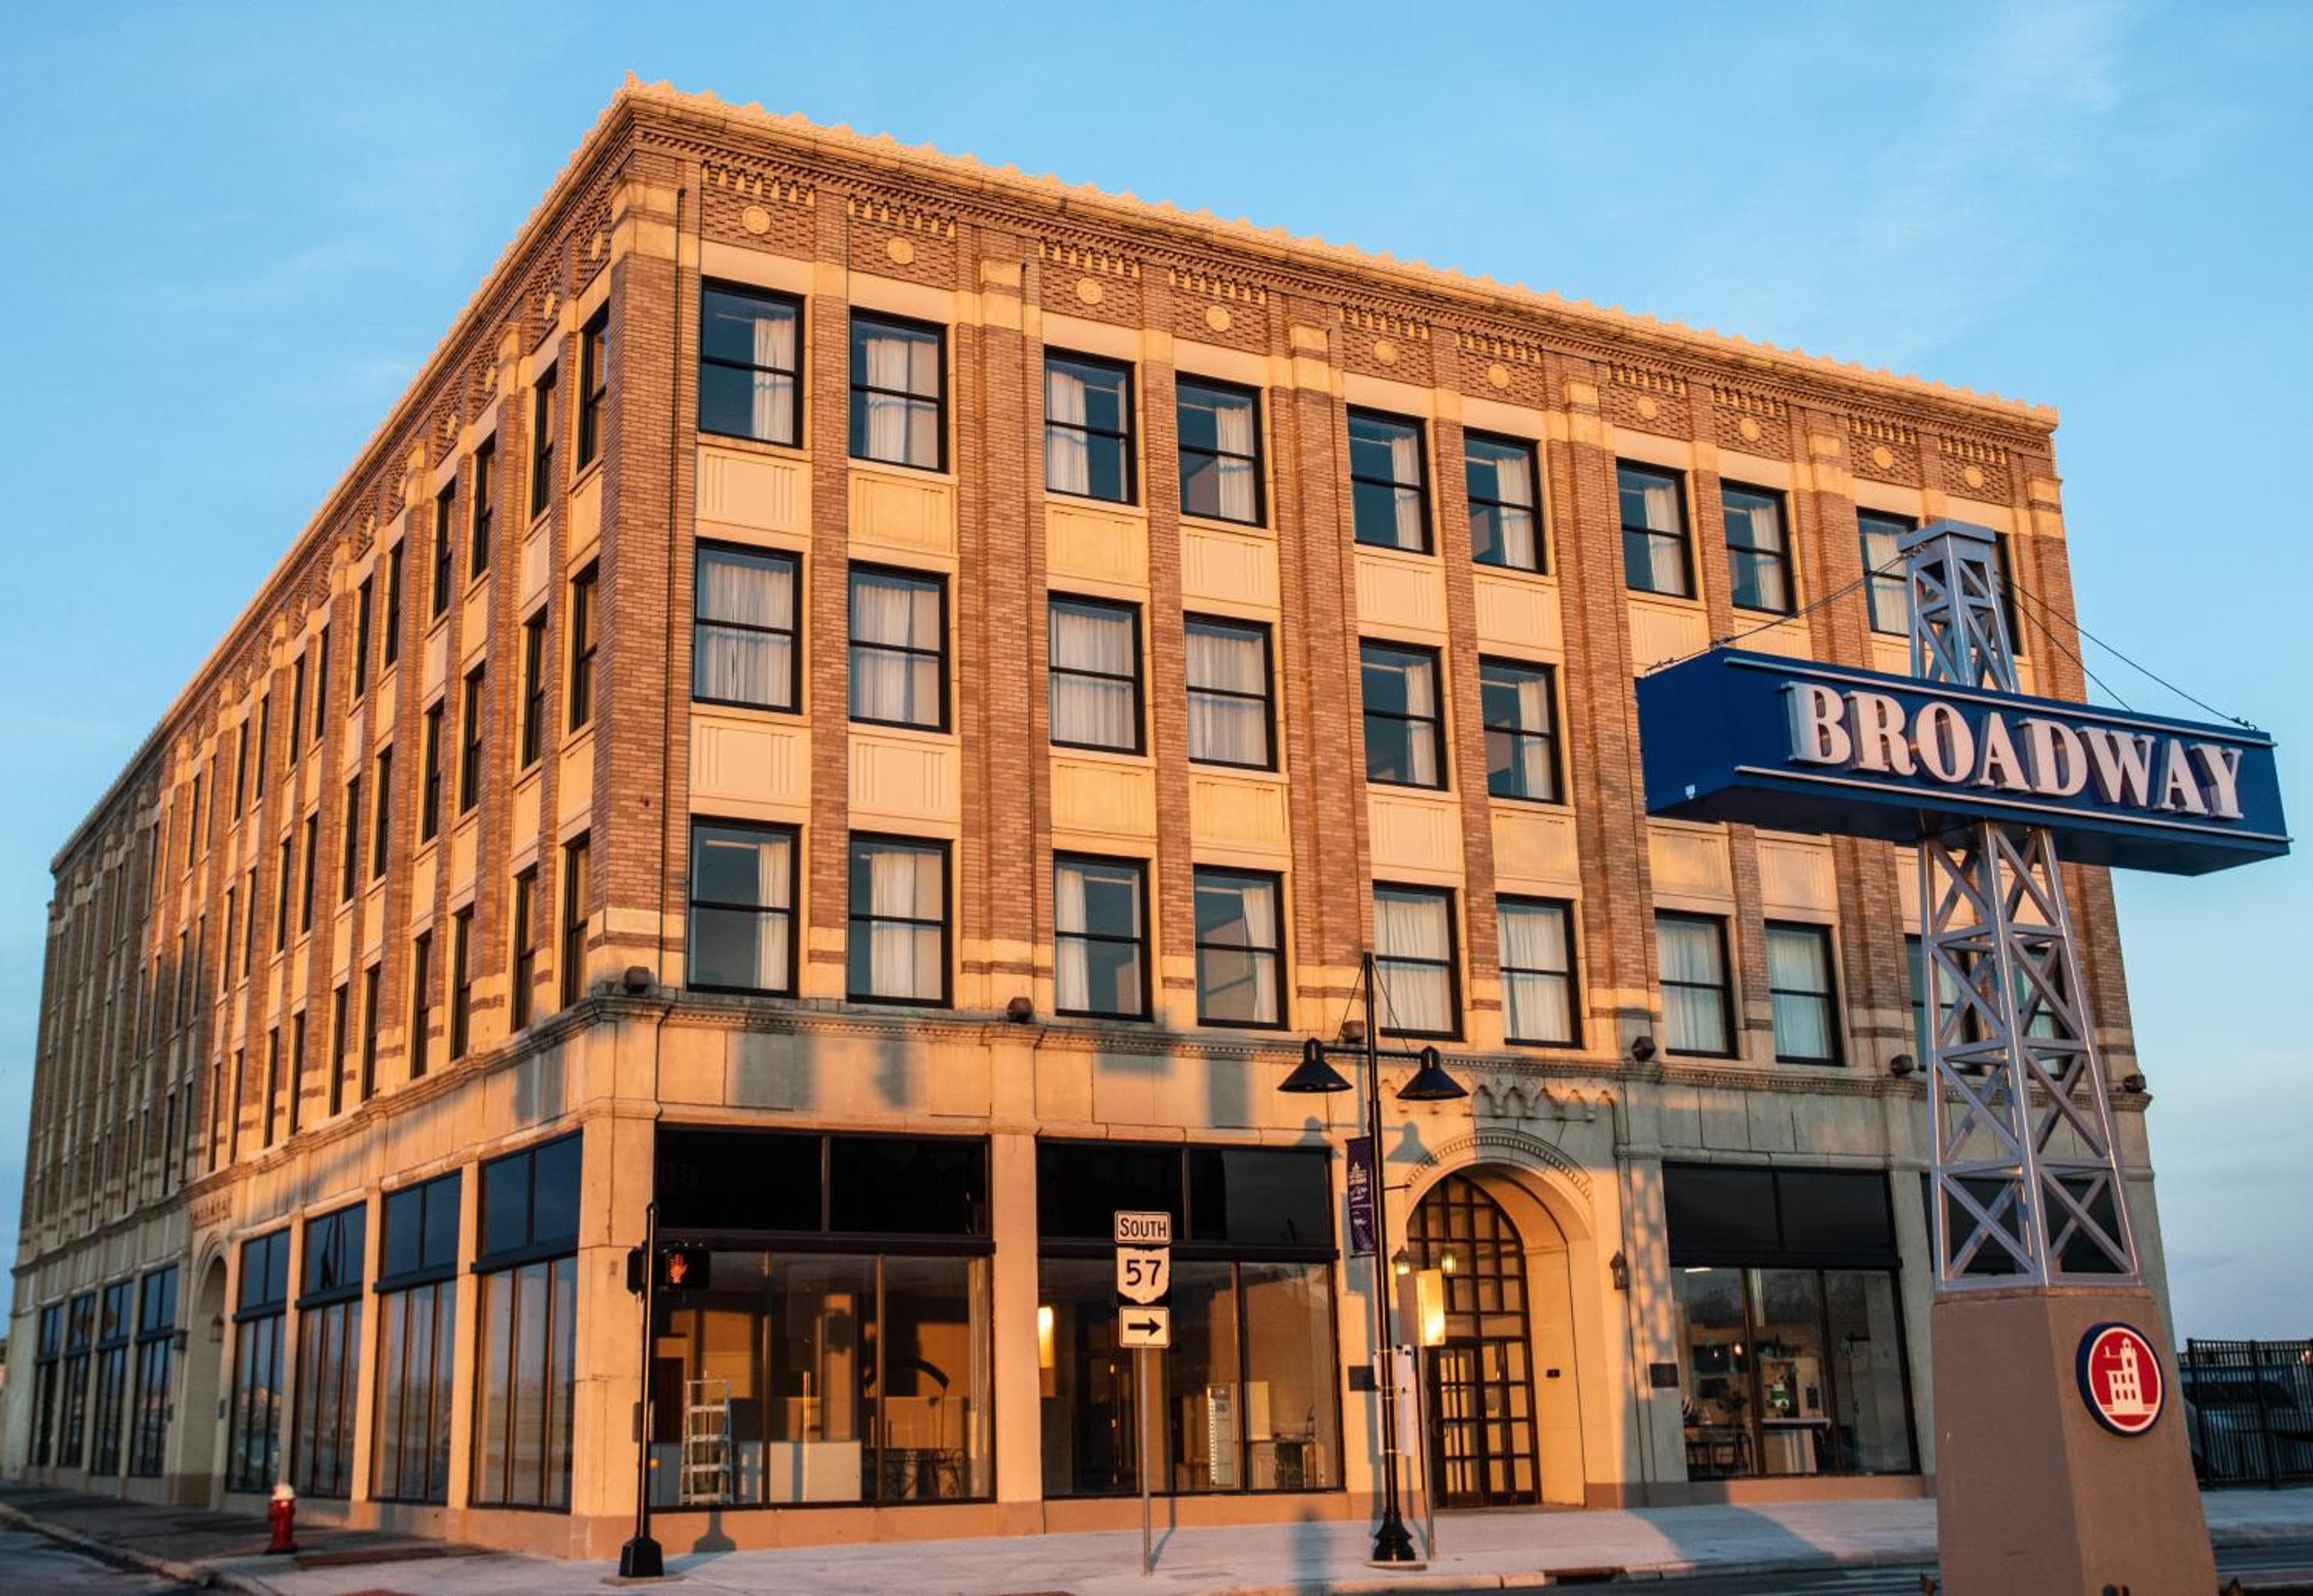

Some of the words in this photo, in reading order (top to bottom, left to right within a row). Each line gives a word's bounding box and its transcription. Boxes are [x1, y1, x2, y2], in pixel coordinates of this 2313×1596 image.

[1783, 681, 2244, 820] BROADWAY
[1120, 1217, 1167, 1237] SOUTH
[1126, 1259, 1161, 1286] 57
